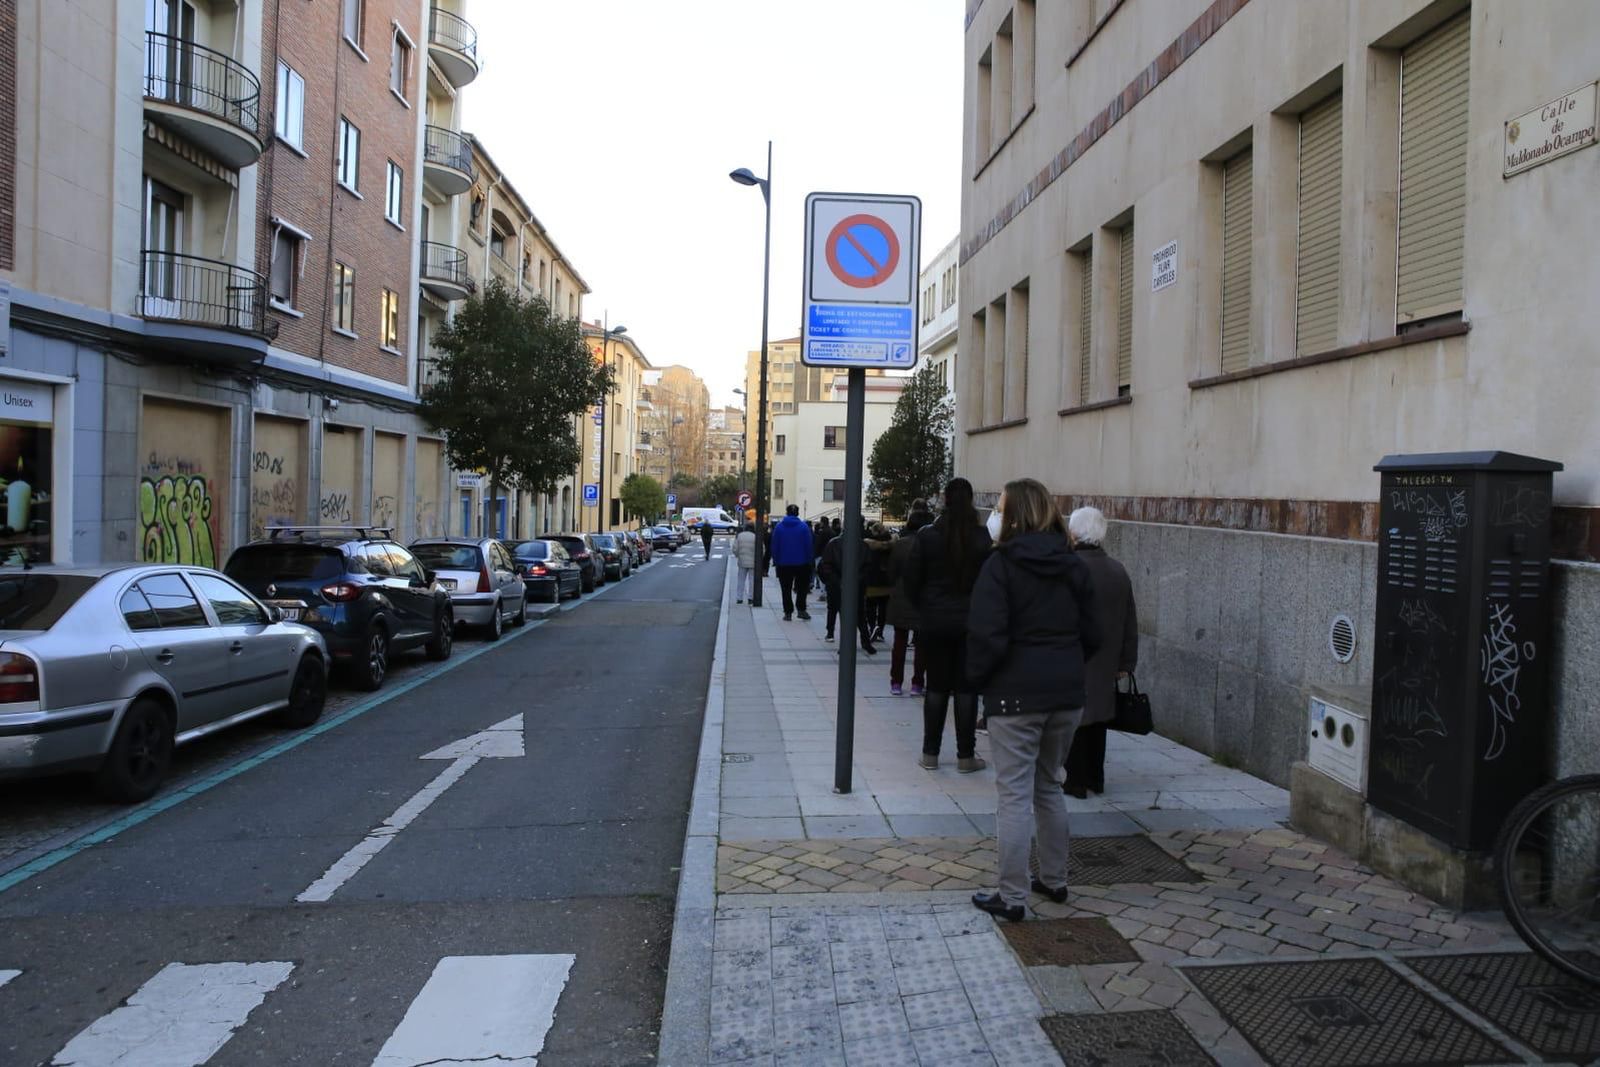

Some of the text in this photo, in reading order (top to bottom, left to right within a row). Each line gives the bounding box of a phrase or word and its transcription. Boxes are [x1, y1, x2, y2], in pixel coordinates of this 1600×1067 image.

[1541, 98, 1576, 122] Calle
[1551, 119, 1564, 134] de
[1507, 126, 1595, 168] Maldonado Ocampo
[4, 392, 33, 408] Unisex
